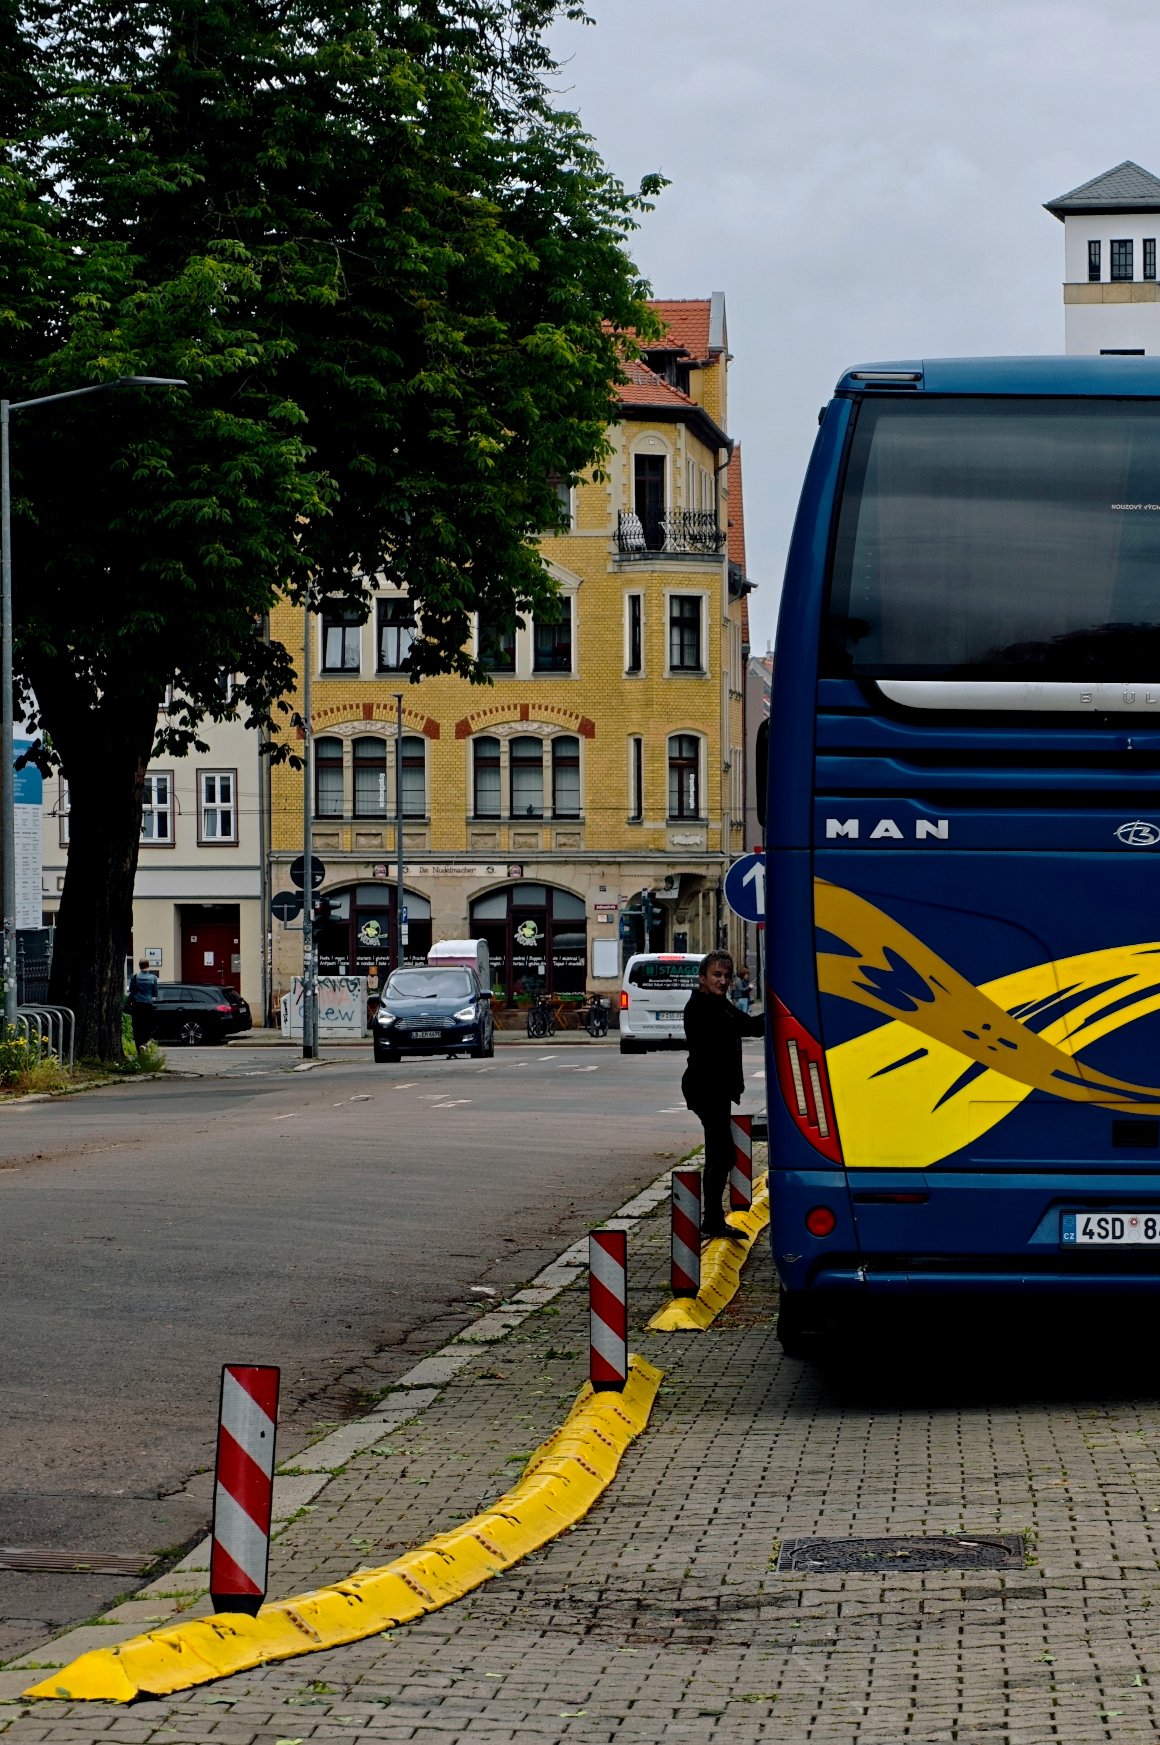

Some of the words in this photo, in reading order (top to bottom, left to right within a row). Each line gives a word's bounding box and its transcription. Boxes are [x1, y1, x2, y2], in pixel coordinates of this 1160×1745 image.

[825, 818, 949, 840] MAN
[1063, 1232, 1075, 1240] CZ
[1082, 1217, 1124, 1240] 4SD
